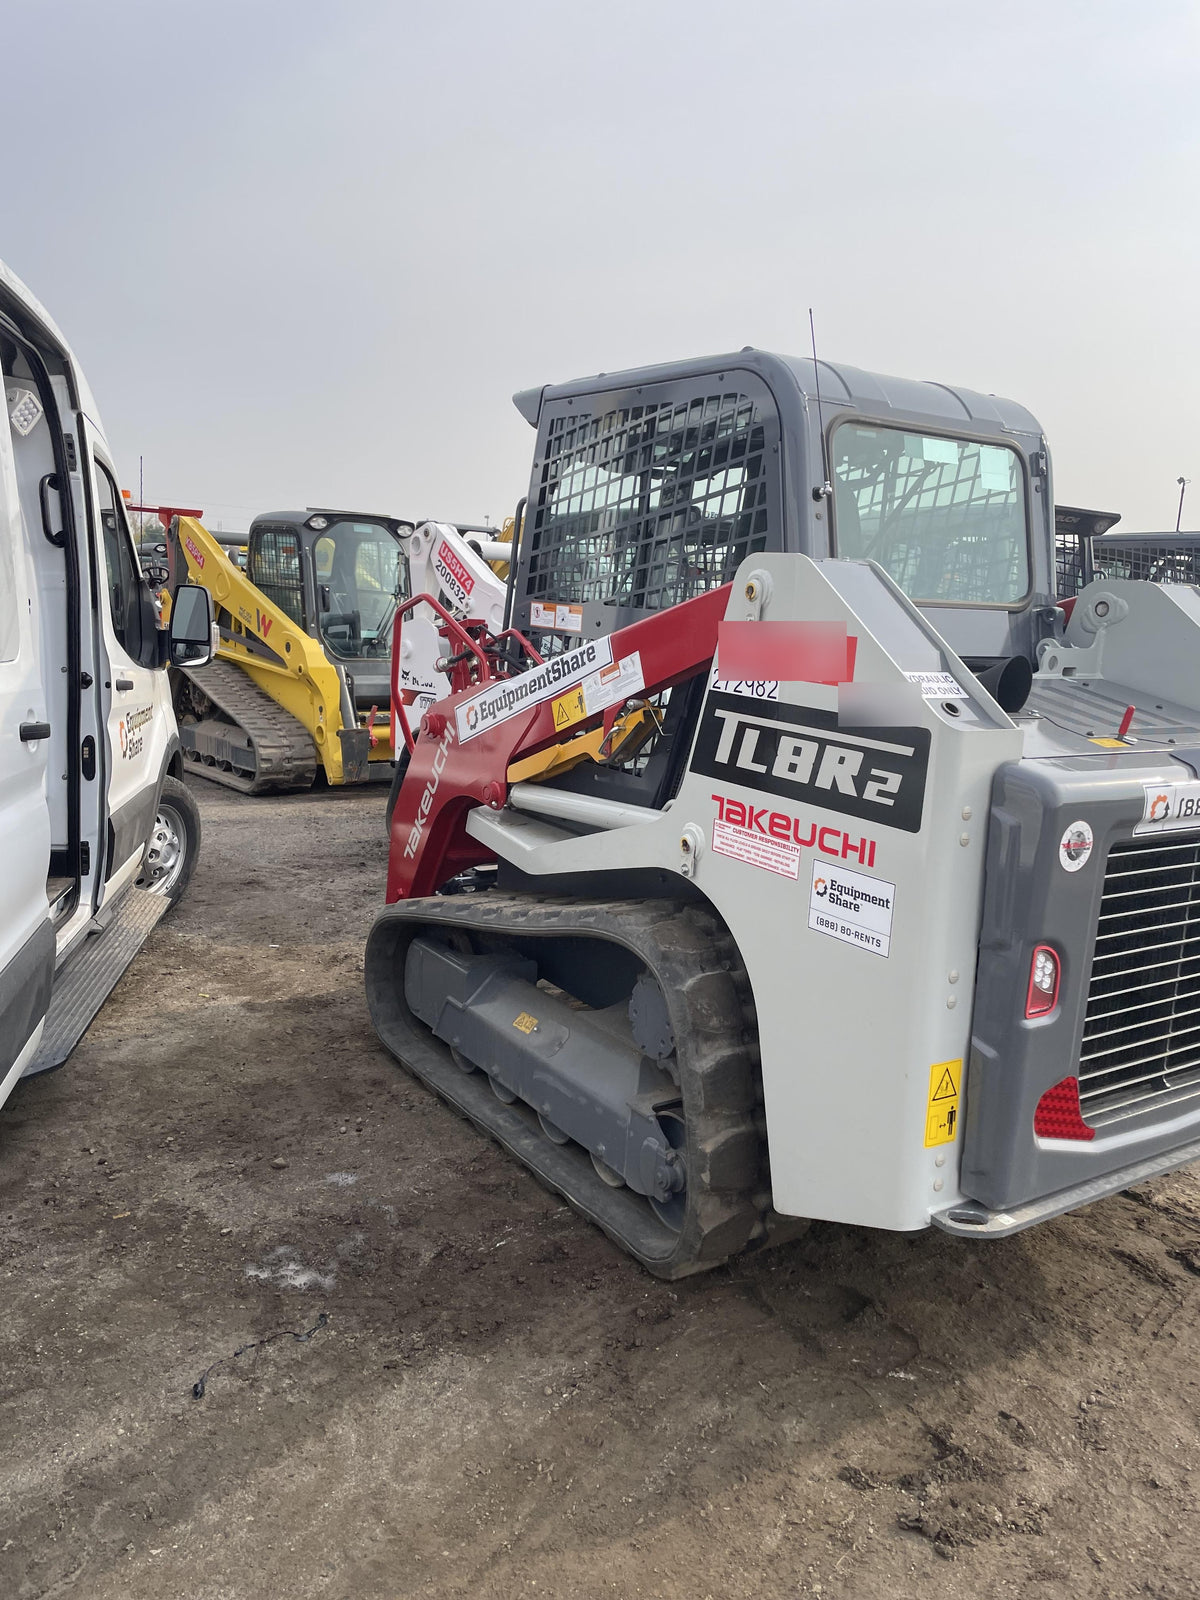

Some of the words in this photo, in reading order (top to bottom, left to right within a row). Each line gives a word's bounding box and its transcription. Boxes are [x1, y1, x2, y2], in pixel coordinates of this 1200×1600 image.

[435, 559, 466, 604] 200832
[479, 644, 597, 721] EquipmentShare
[905, 675, 954, 684] YDRAULIC
[126, 703, 153, 736] Equipment
[128, 737, 143, 761] Share
[732, 826, 758, 841] CUSTOMER
[758, 834, 800, 854] RESPONSIBILITY
[828, 893, 860, 913] Share
[829, 879, 890, 910] Equipment
[816, 915, 838, 933] (888)
[840, 924, 882, 949] 80-RENTS
